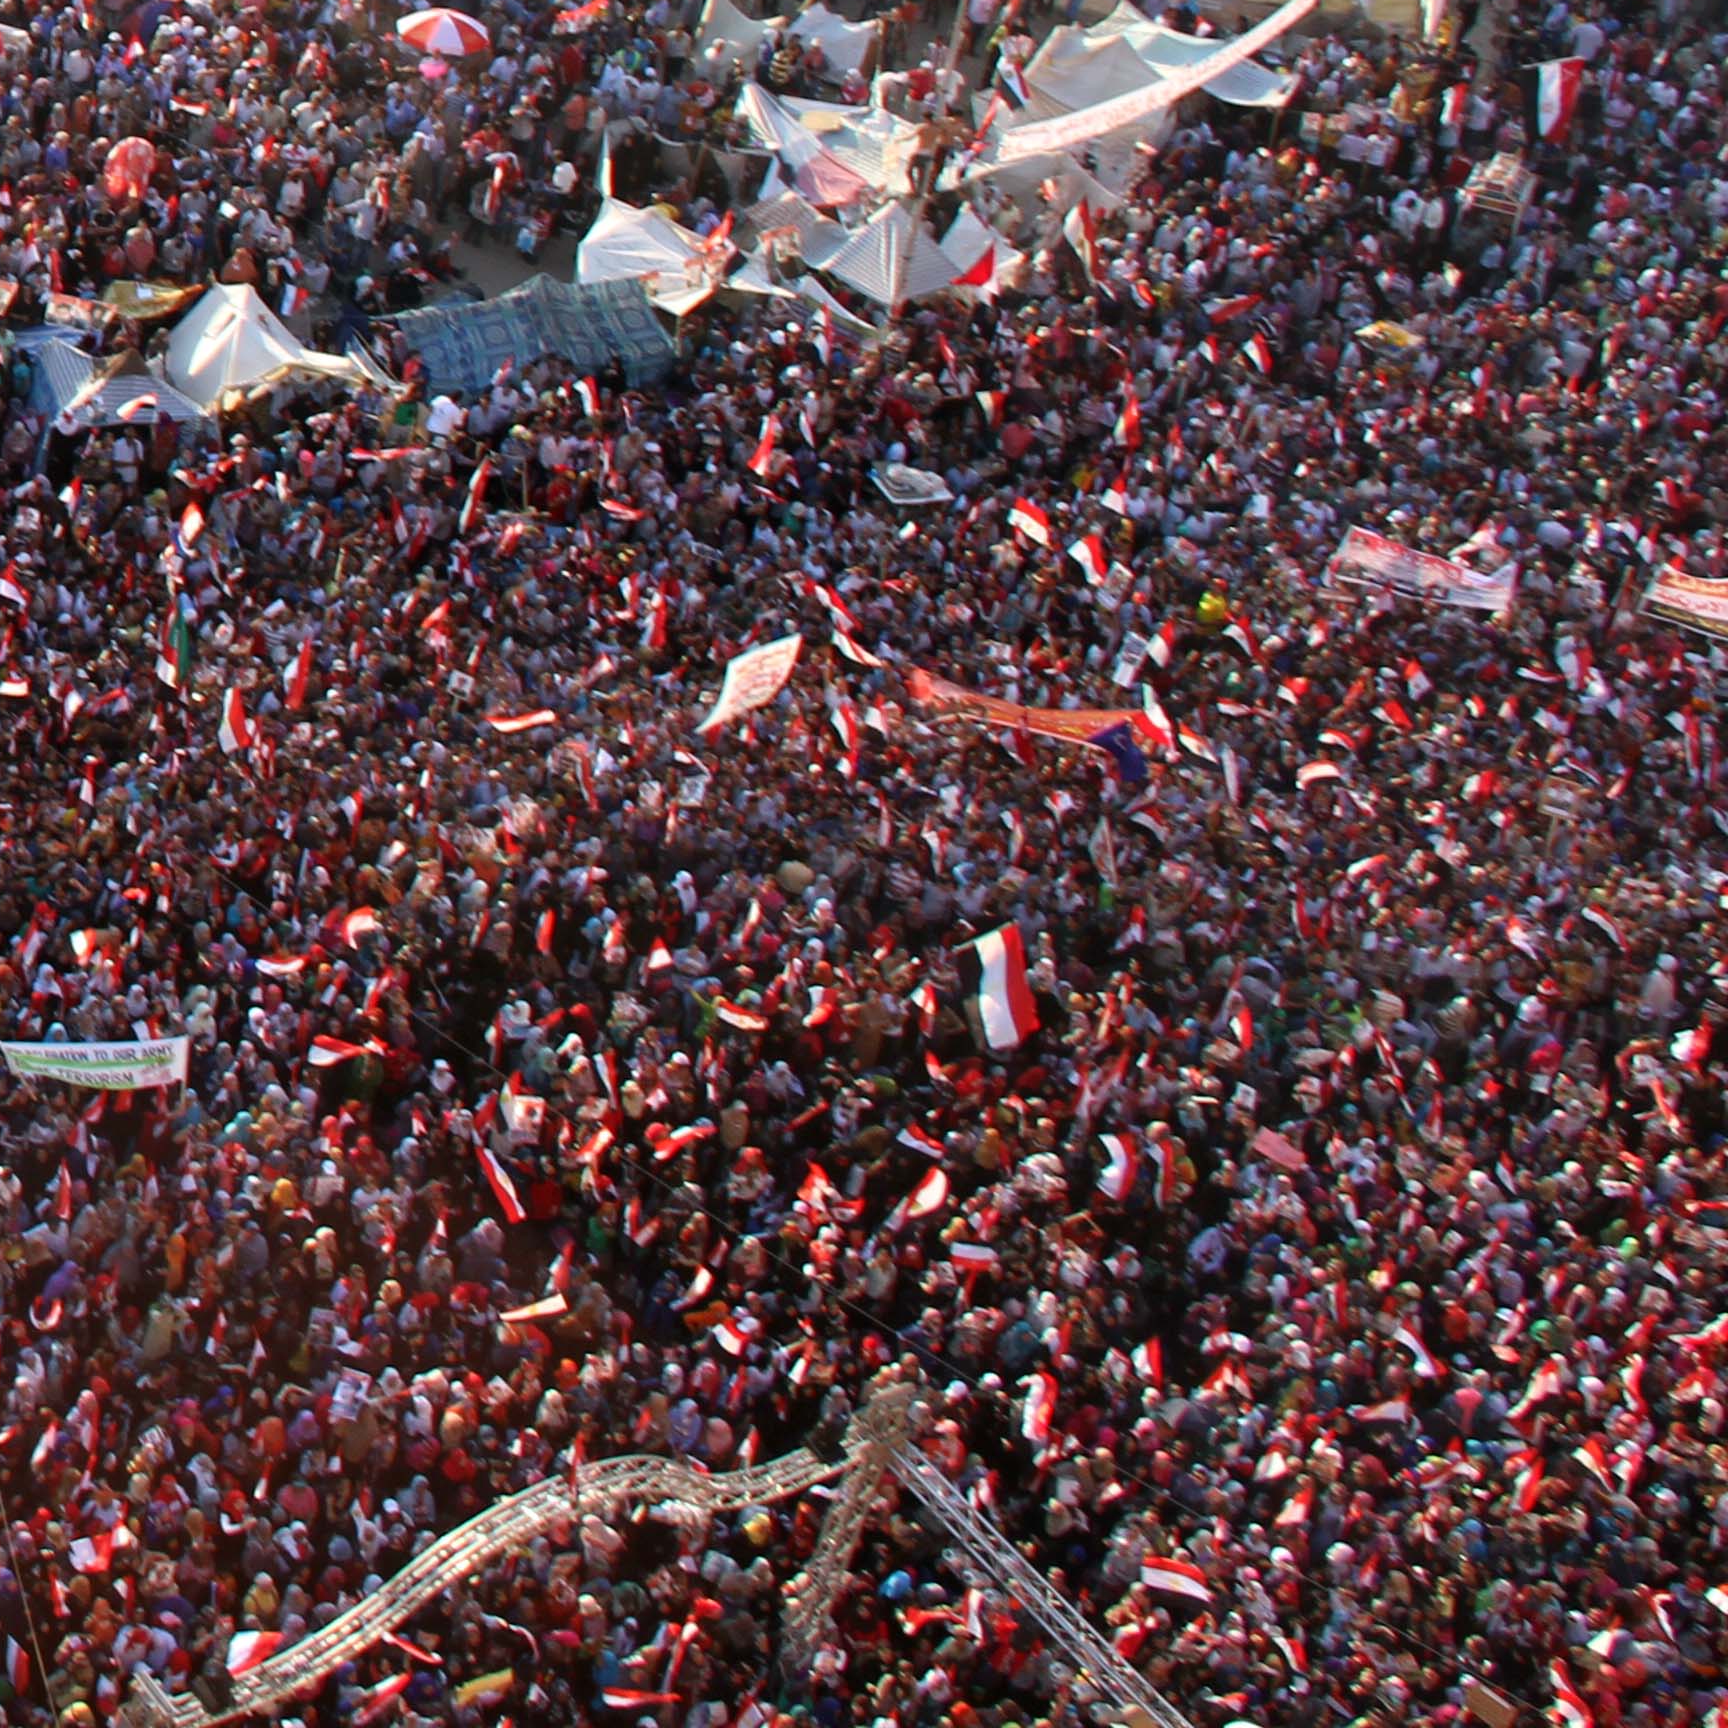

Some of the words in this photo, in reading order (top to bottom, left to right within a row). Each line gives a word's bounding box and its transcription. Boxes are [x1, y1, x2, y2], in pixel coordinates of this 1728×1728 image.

[93, 1048, 108, 1061] TO
[112, 1047, 137, 1061] OUR
[141, 1043, 174, 1059] ARMY
[57, 1067, 134, 1085] TERRORISM
